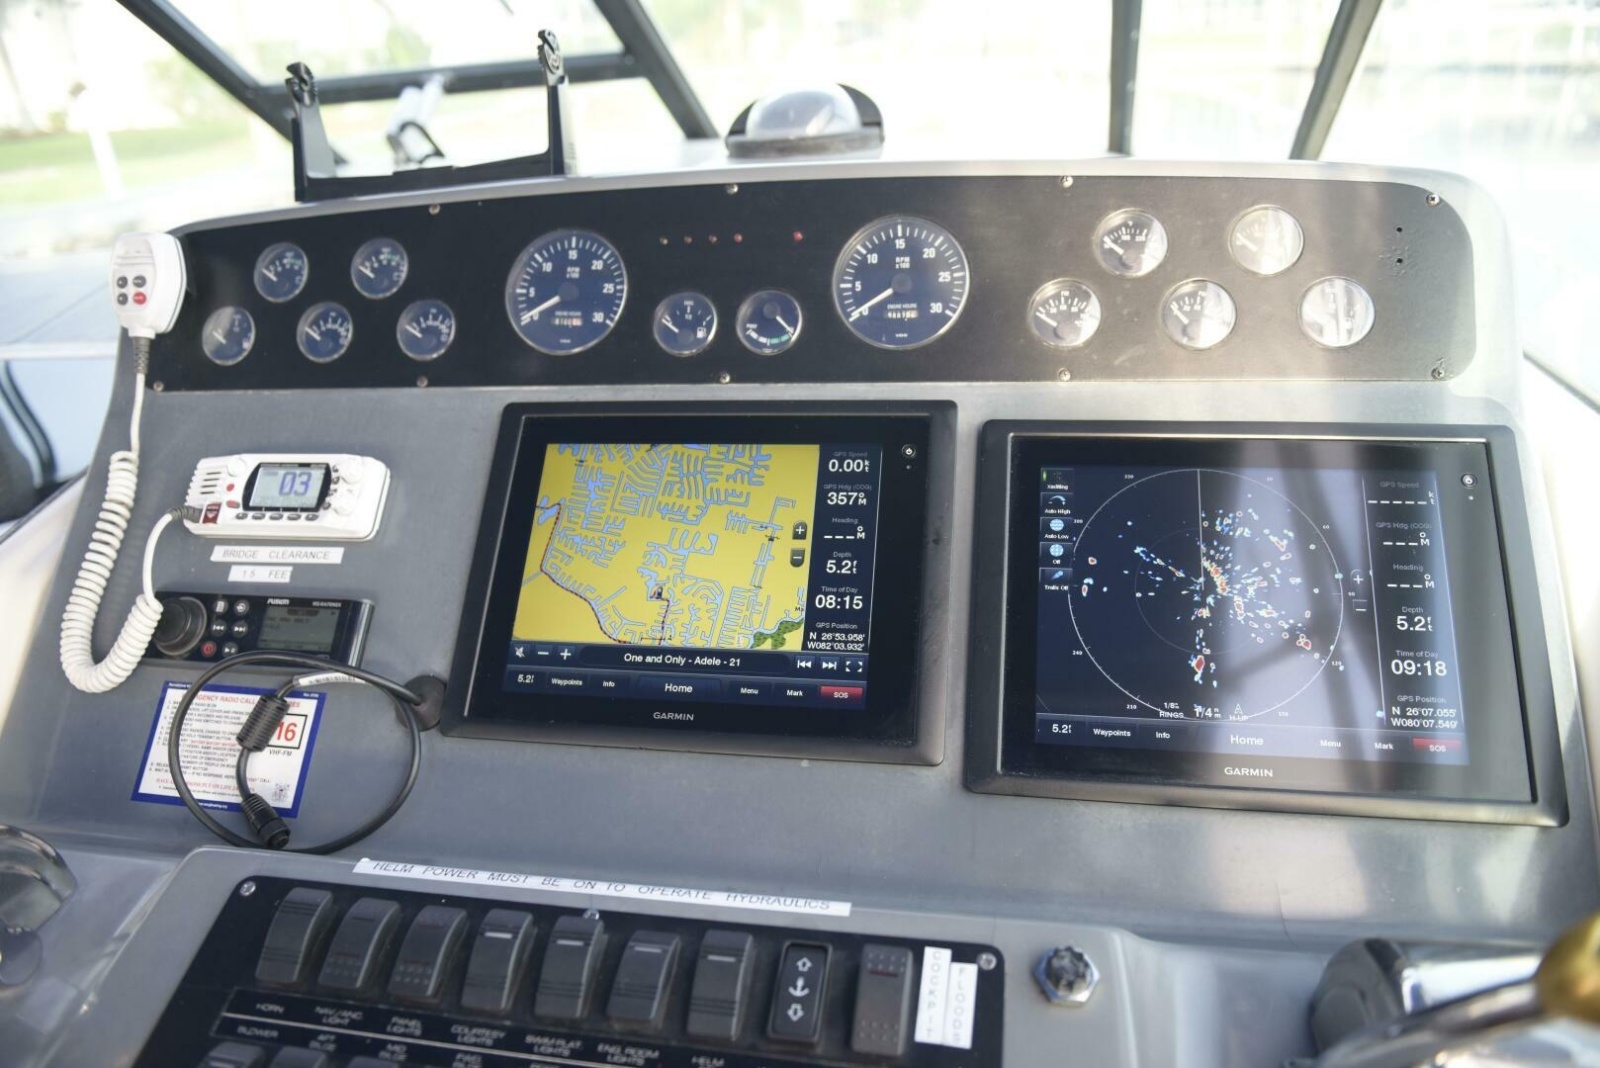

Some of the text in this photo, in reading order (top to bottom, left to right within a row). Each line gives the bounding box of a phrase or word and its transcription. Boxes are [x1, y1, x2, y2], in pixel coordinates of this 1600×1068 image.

[895, 239, 906, 249] 15
[568, 250, 578, 260] 15
[923, 248, 936, 258] 20
[867, 253, 878, 264] 10
[542, 262, 552, 272] 10
[591, 260, 604, 270] 20
[938, 272, 951, 282] 25
[603, 283, 614, 294] 25
[855, 281, 861, 291] 5
[529, 287, 535, 297] 5
[930, 303, 943, 313] 30
[592, 312, 604, 322] 30
[278, 471, 312, 497] 03
[222, 548, 331, 560] BRIDGE CLEARANCE
[1393, 564, 1423, 572] Heading
[815, 594, 863, 610] 08:15
[1402, 606, 1423, 614] Depth
[809, 632, 817, 640] N
[624, 653, 643, 663] One
[645, 654, 662, 663] and
[664, 655, 686, 666] Only
[694, 656, 721, 666] Adele
[729, 658, 741, 666] 21
[1391, 659, 1447, 676] 09:18
[551, 678, 583, 687] Waypoints
[664, 683, 693, 693] Home
[740, 687, 759, 695] Menu
[786, 689, 803, 697] Mark
[220, 695, 256, 705] RADIO CALL
[833, 691, 849, 699] SOS
[1415, 696, 1446, 704] Position
[653, 711, 694, 721] GARMIN
[1159, 711, 1184, 719] RINGS
[1392, 707, 1400, 715] N
[277, 721, 297, 742] 16
[1093, 728, 1131, 738] Waypoints
[1155, 731, 1170, 739] Info
[1230, 735, 1264, 746] Home
[1320, 739, 1341, 748] Menu
[1374, 742, 1394, 750] Mark
[1429, 744, 1446, 752] SOS
[269, 749, 292, 757] VHF-FM
[1224, 766, 1273, 777] GARMIN
[373, 861, 831, 910] HELM POWER MUST BE ON TO OPERATE HYDRAULICS
[256, 1003, 285, 1014] HORN
[237, 1025, 279, 1038] BLOWER
[533, 1045, 571, 1057] LIGHTS
[607, 1054, 646, 1066] LIGHTS
